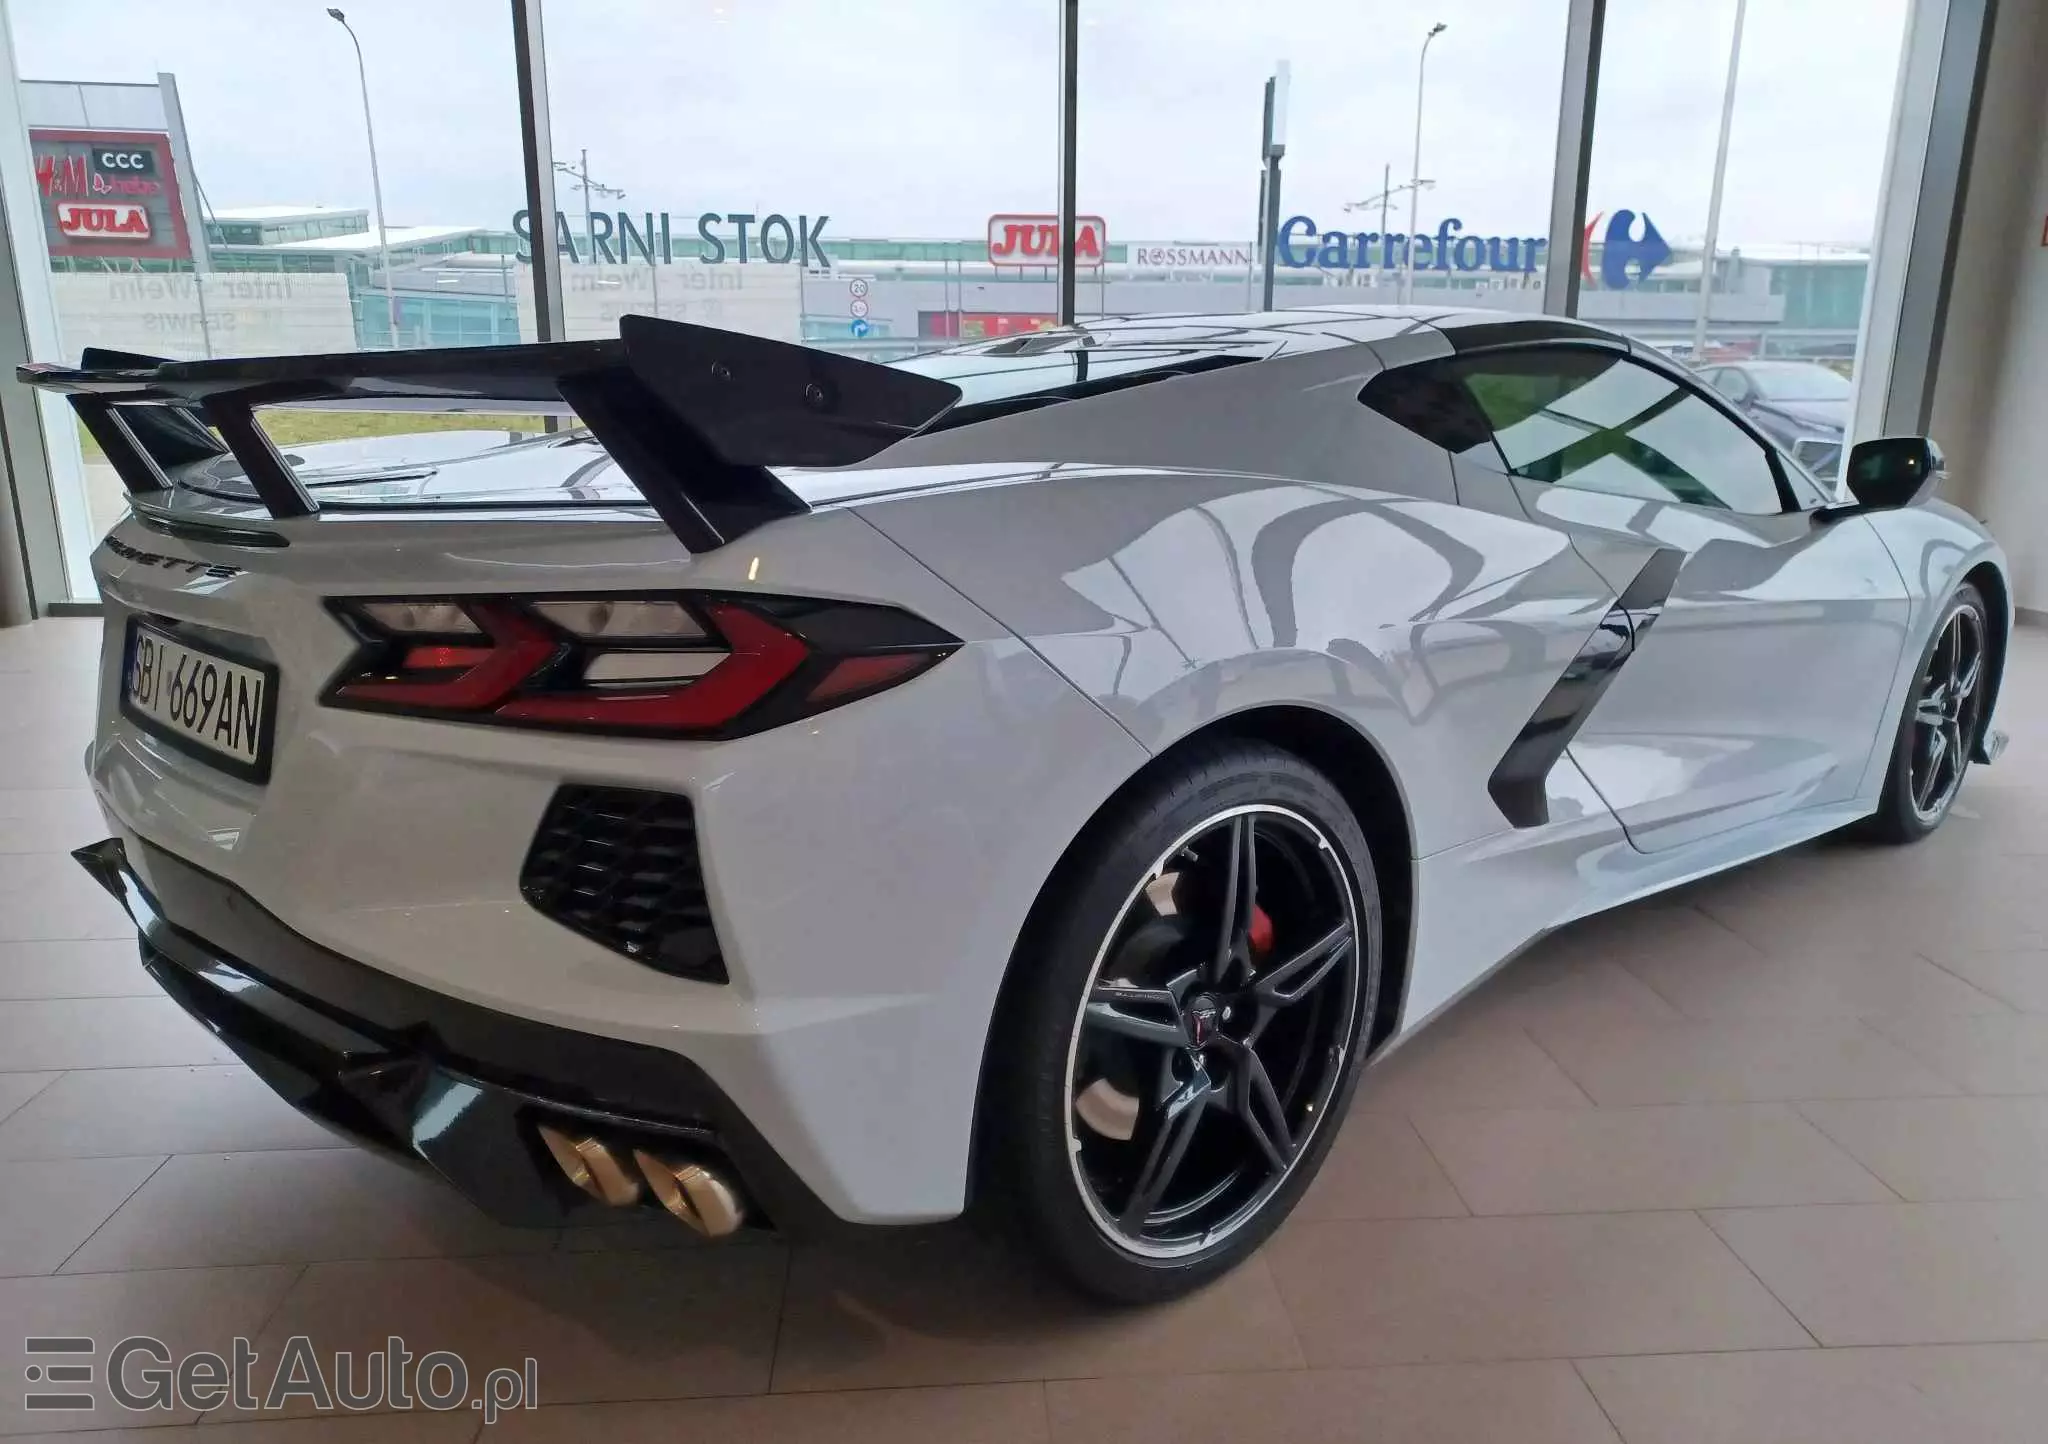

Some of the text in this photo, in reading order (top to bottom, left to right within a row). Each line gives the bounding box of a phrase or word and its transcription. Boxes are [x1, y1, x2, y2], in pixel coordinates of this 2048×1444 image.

[35, 152, 89, 197] H&M
[101, 152, 145, 170] CCC
[60, 207, 149, 233] JULA
[512, 209, 832, 268] SARNI STOK
[1137, 246, 1250, 267] ROSSMANN
[1278, 215, 1549, 273] Carrefour
[105, 535, 242, 578] VETTE
[170, 653, 262, 756] 669AN
